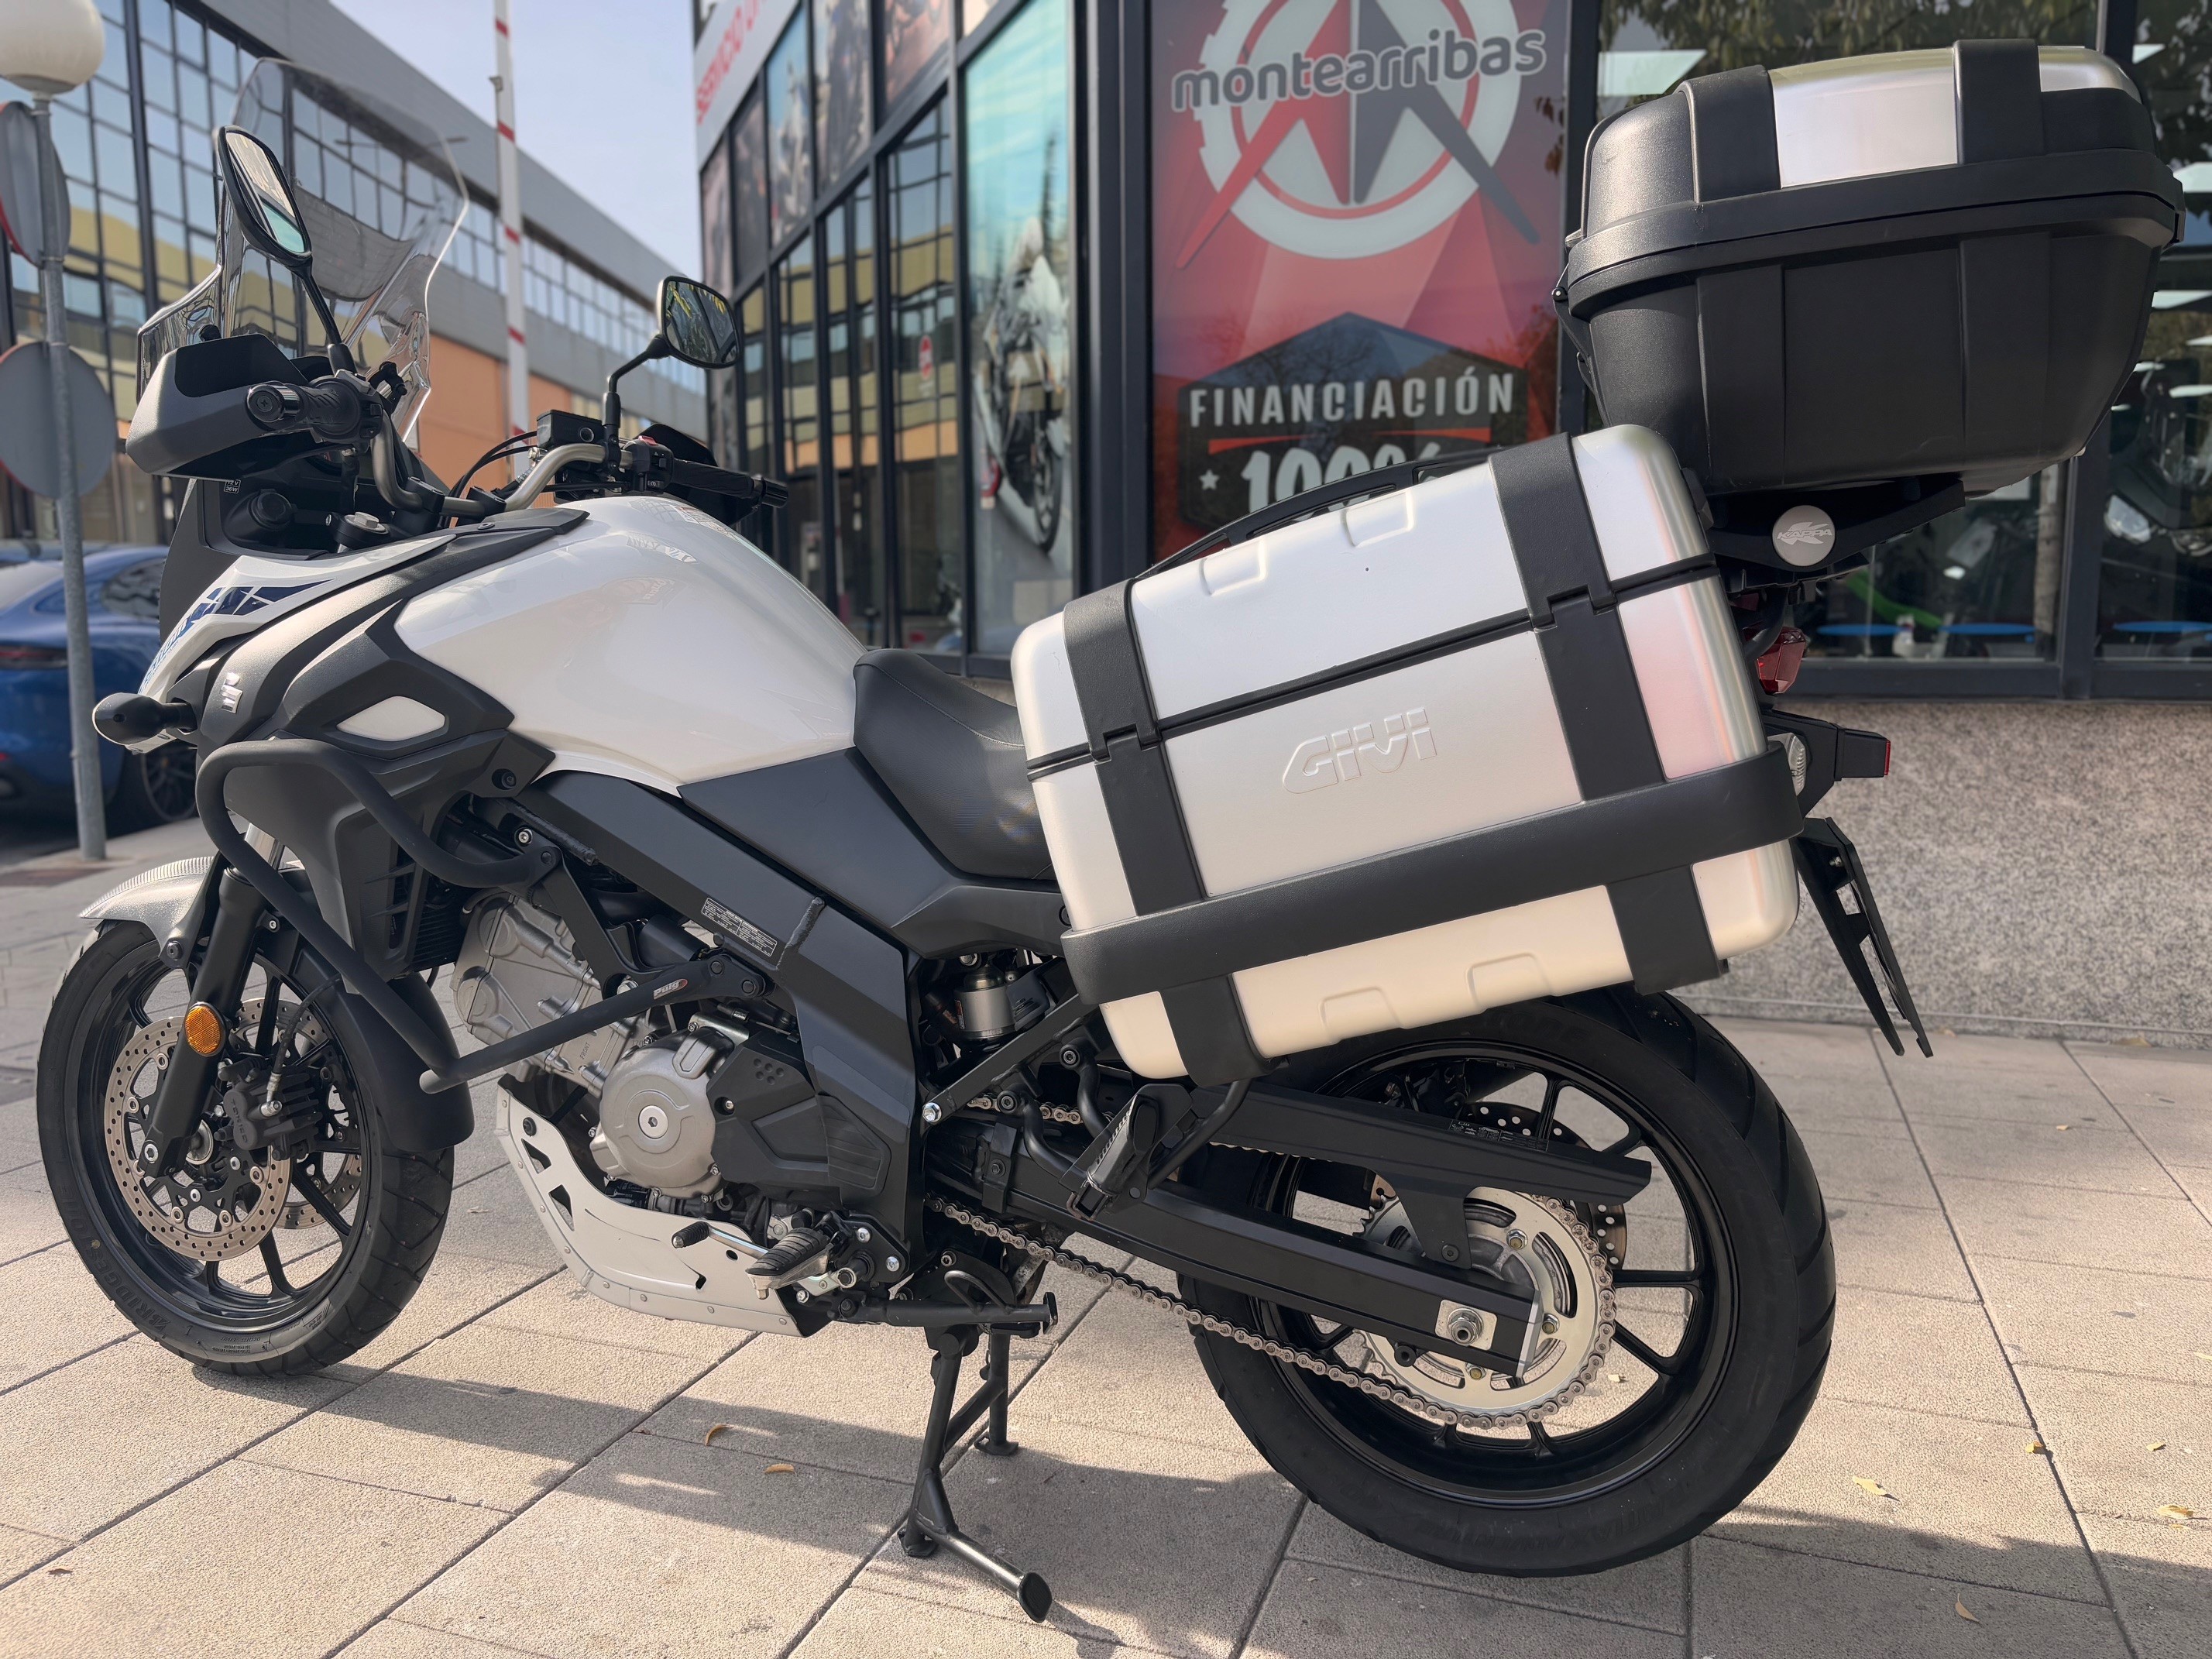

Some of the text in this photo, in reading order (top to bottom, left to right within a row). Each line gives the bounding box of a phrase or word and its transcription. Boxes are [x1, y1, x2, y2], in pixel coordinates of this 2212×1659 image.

[1172, 29, 1547, 110] montearribas
[1190, 366, 1514, 428] FINANCIACIÓN
[1777, 528, 1833, 541] KAPPA
[1283, 706, 1437, 795] GIVI
[654, 981, 680, 998] Puig
[579, 1042, 590, 1060] FRONT
